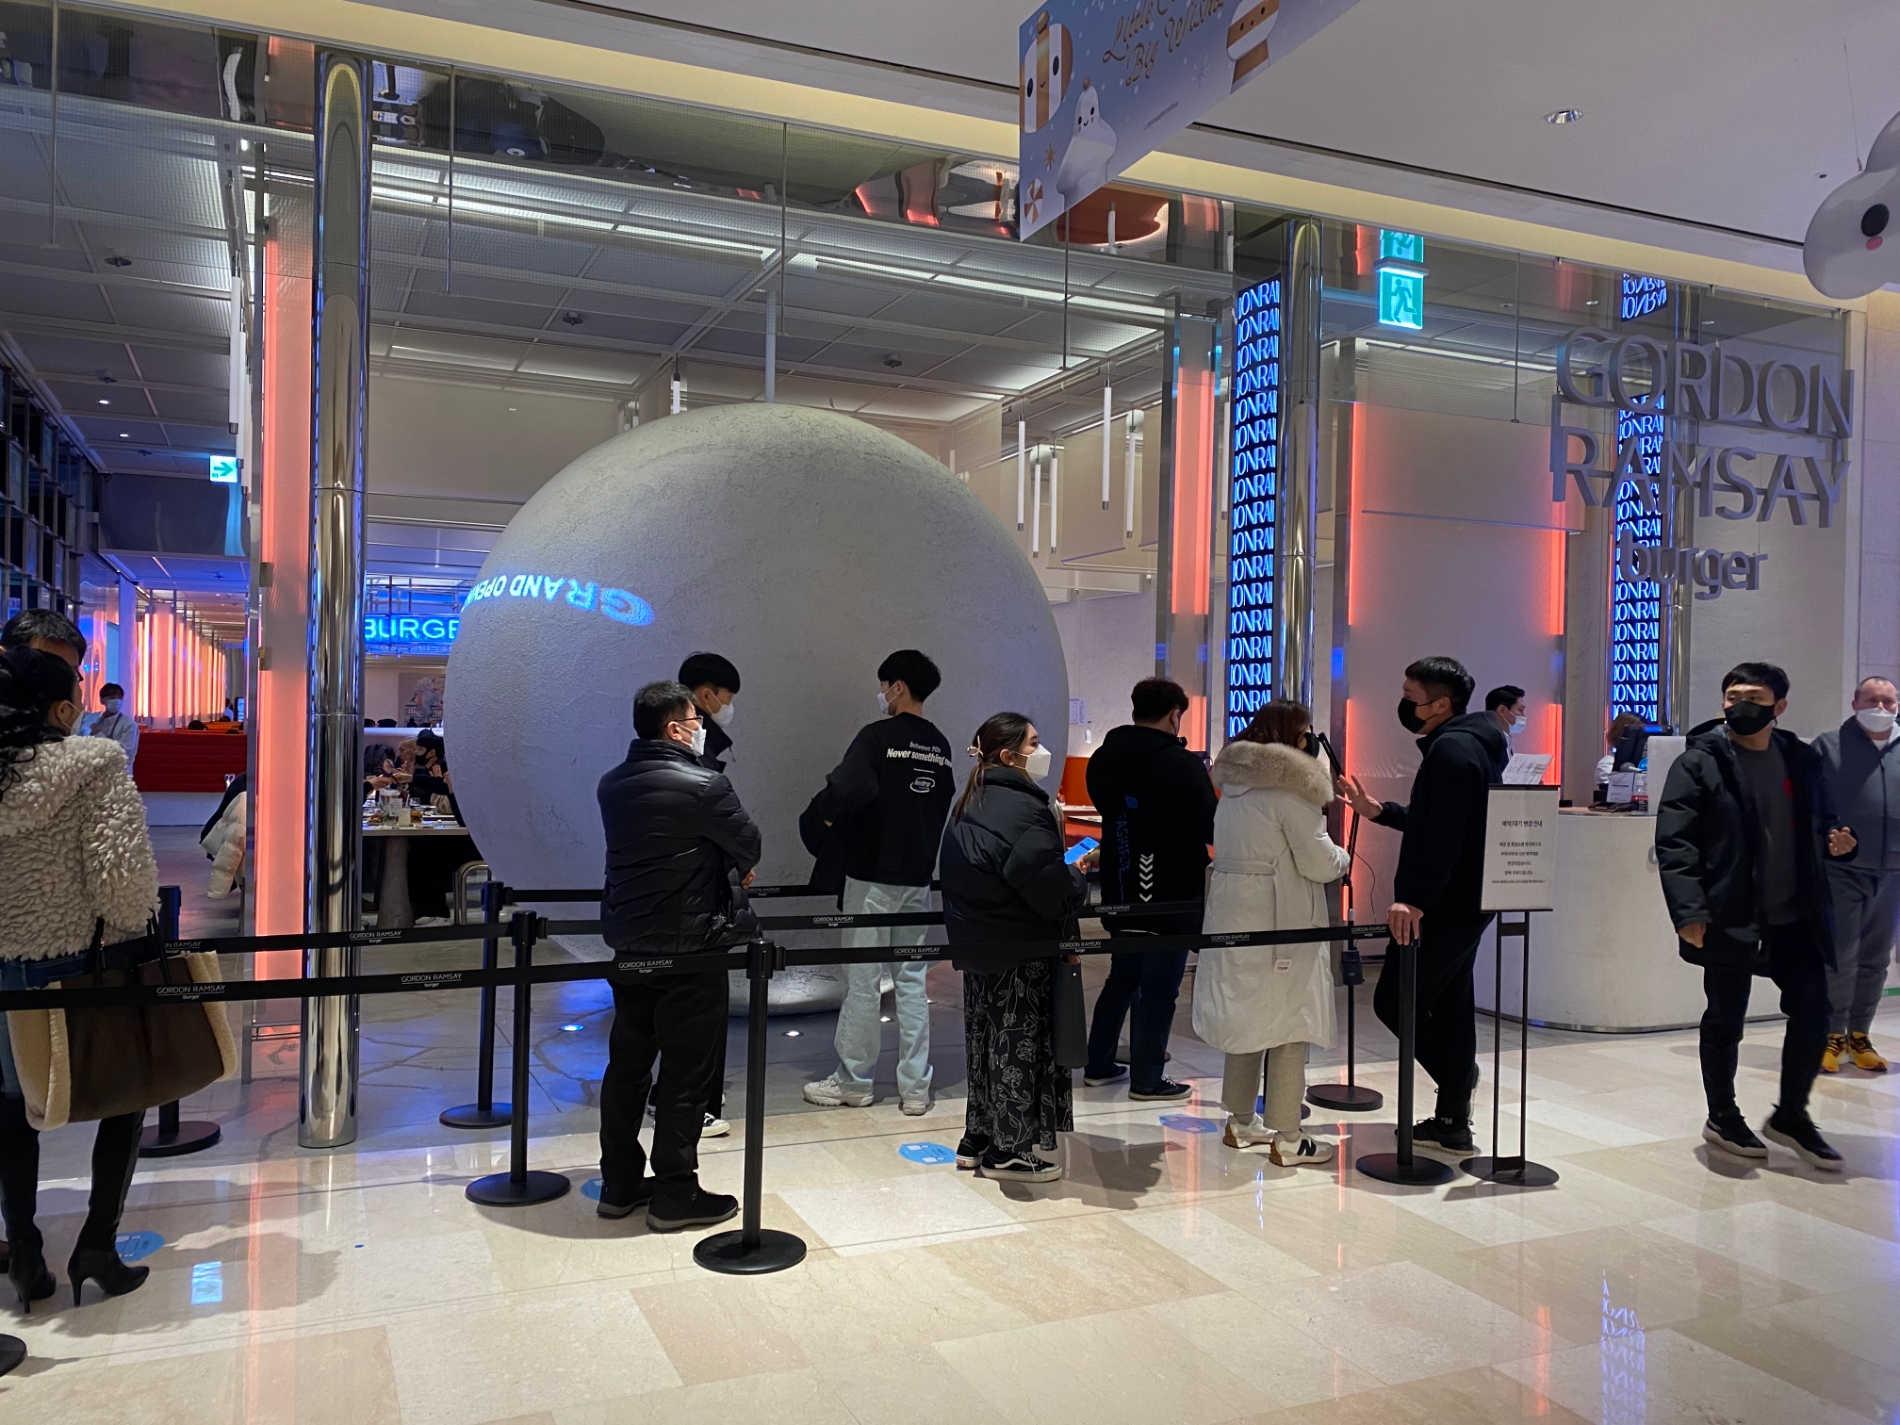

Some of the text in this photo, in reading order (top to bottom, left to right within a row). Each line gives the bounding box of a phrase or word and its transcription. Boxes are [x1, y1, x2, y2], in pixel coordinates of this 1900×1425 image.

[1555, 326, 1855, 439] GORDON
[1551, 425, 1851, 529] RAMSAY
[1619, 529, 1768, 600] burger
[510, 574, 654, 627] GRAND
[887, 747, 911, 759] Never
[911, 751, 945, 766] something
[401, 975, 432, 983] GORDON
[646, 959, 673, 967] RAMSAY
[156, 986, 191, 994] GORDON
